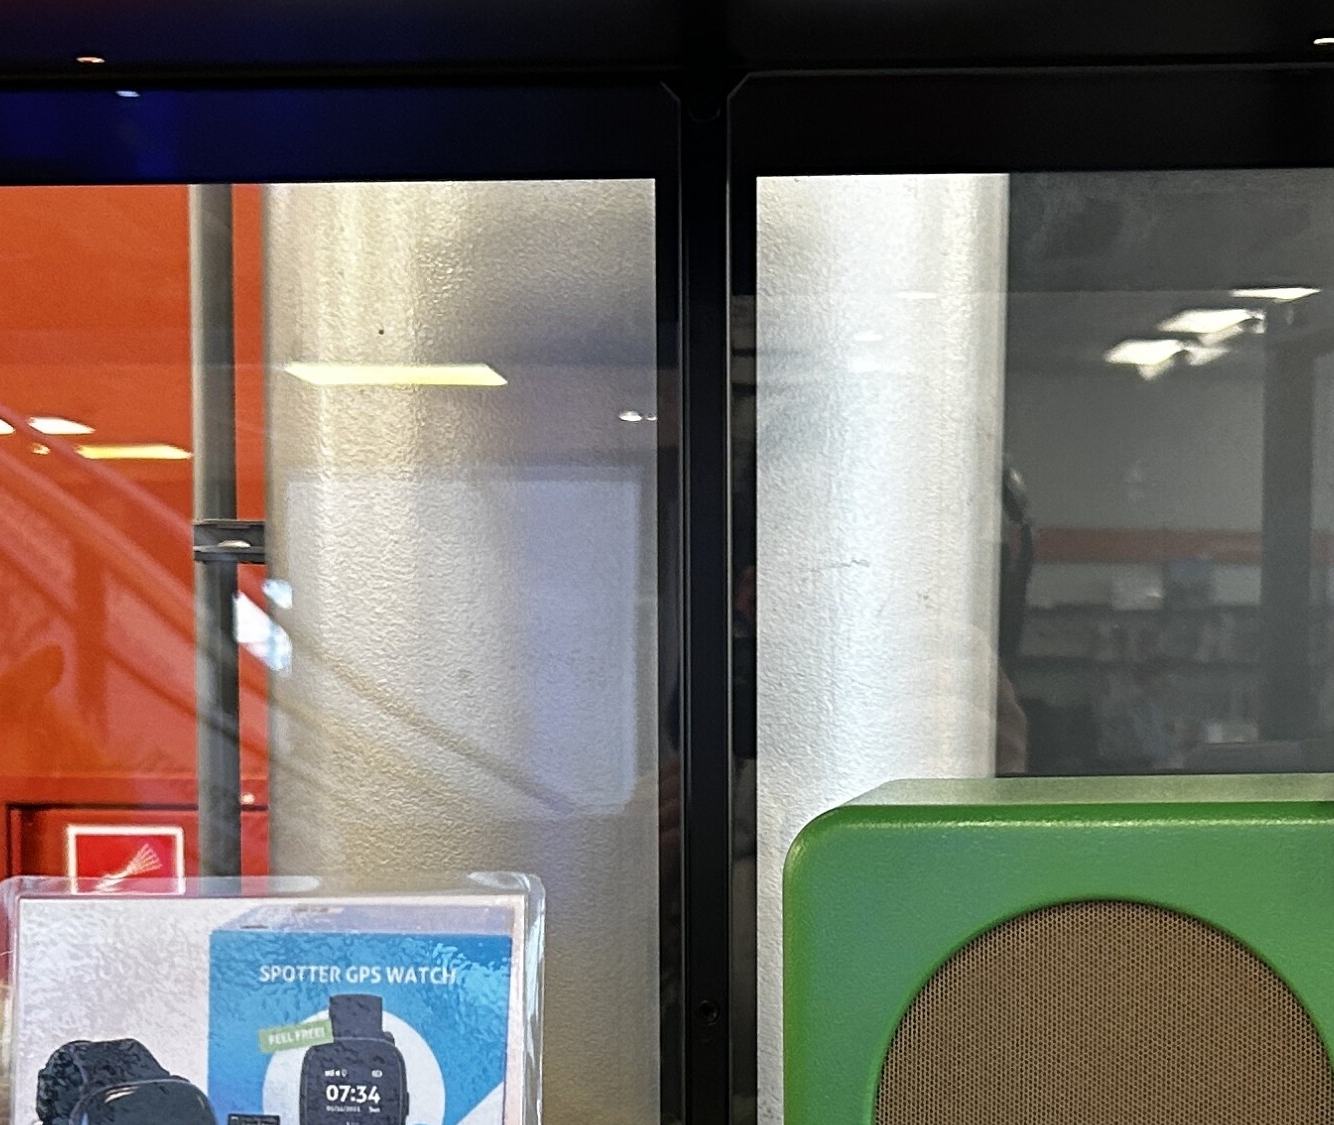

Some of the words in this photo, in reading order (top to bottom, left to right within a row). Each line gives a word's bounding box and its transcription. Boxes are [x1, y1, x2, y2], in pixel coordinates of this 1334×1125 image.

[259, 964, 341, 984] SPOTTER
[345, 965, 382, 984] GPS
[385, 966, 458, 985] WATCH
[268, 1029, 295, 1045] FEEL
[325, 1084, 381, 1104] 07:34
